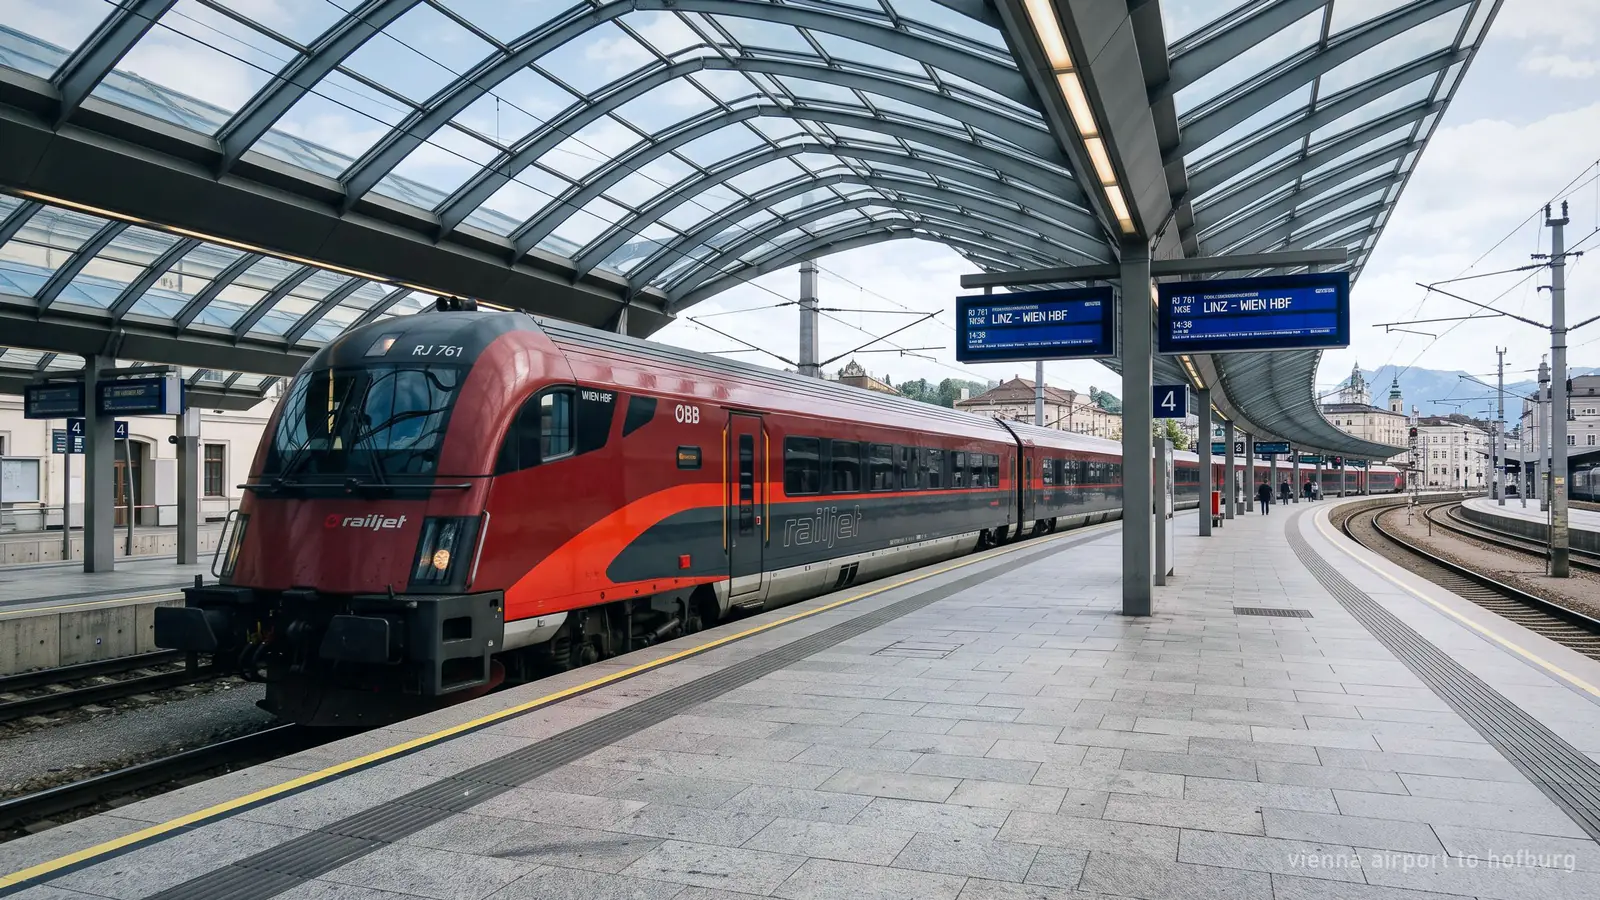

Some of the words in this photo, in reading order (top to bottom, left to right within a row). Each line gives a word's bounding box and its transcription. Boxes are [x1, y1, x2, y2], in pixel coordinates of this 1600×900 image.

[1182, 295, 1195, 304] 761
[1203, 300, 1228, 313] LINZ
[1240, 298, 1266, 311] WIEN
[1270, 297, 1293, 310] HBF
[992, 313, 1013, 324] LINZ
[1022, 311, 1046, 323] WIEN
[1048, 309, 1068, 321] HBF
[1172, 320, 1192, 329] 14:38
[412, 344, 434, 356] RJ
[435, 345, 463, 357] 761
[581, 390, 600, 402] WIEN
[600, 392, 613, 403] HBF
[1161, 390, 1177, 412] 4
[72, 422, 82, 434] 4
[116, 424, 125, 436] 4
[342, 514, 407, 531] railjet
[783, 504, 863, 549] railjet
